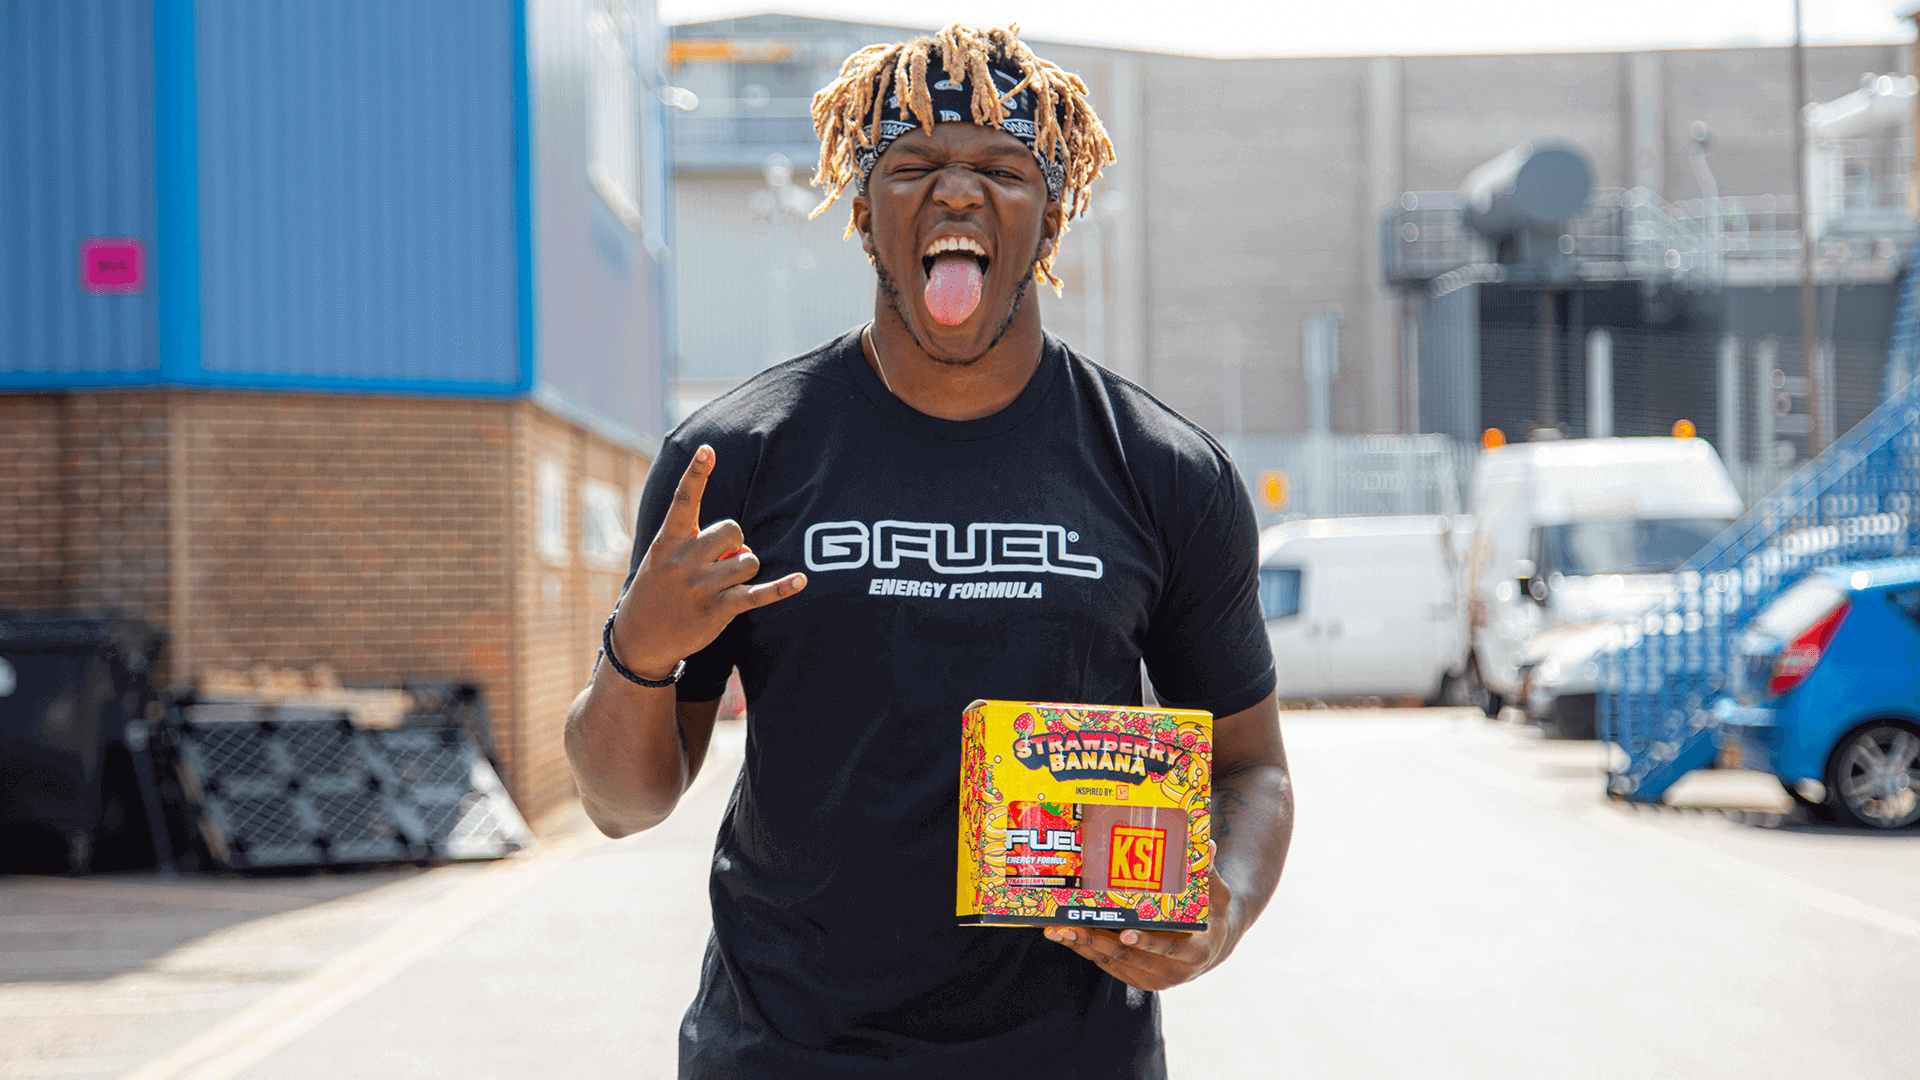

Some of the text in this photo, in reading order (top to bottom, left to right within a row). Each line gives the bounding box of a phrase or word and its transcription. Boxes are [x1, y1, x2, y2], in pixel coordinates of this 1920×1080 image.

[868, 578, 1043, 600] ENERGY FORMULA
[1014, 731, 1184, 767] STRAWBERRY
[1049, 750, 1147, 777] BANANA
[1075, 786, 1103, 796] INSPIRED
[1006, 856, 1067, 865] ENERGY FORMULA
[1111, 836, 1163, 883] KSI
